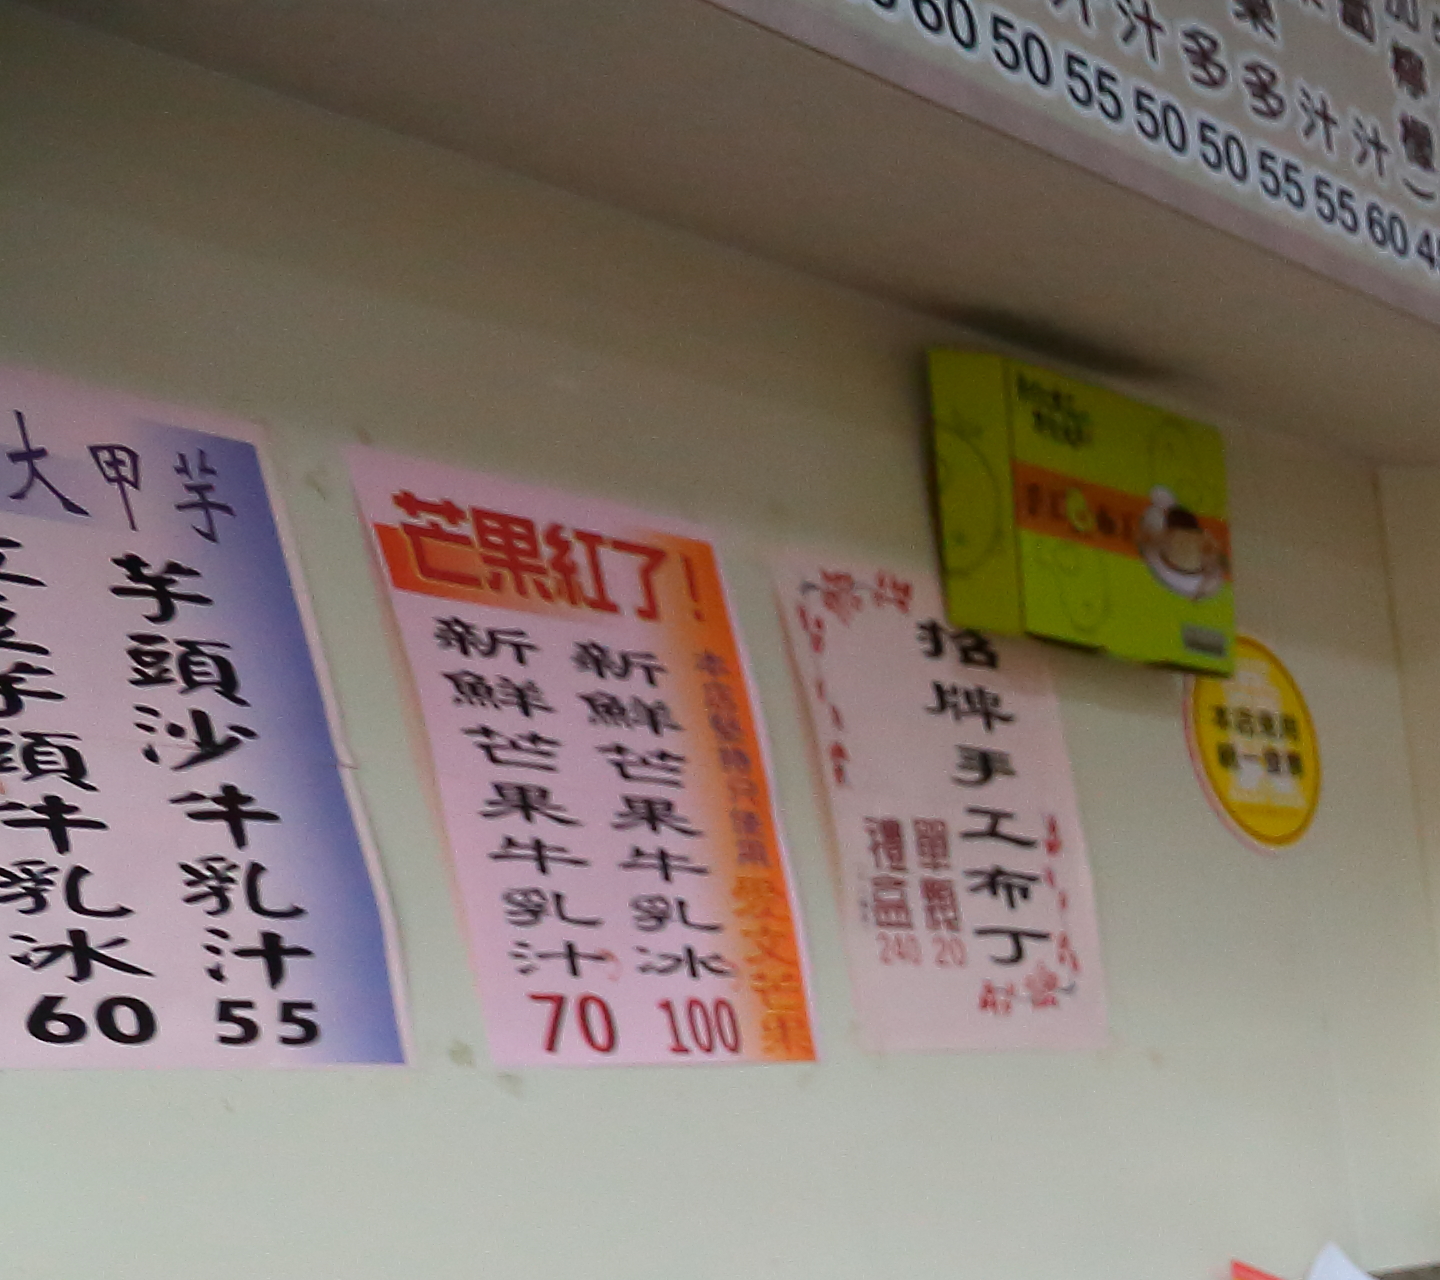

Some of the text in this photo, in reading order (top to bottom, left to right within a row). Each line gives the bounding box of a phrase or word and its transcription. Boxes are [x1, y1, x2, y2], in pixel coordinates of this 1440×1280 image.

[991, 14, 1051, 86] 50
[1064, 50, 1123, 121] 55
[1133, 86, 1188, 153] 50
[1199, 119, 1248, 182] 50
[1257, 149, 1306, 209] 55
[1314, 175, 1359, 235] 55
[1366, 203, 1408, 257] 60
[111, 553, 314, 990] 芋頭沙牛乳汁
[432, 616, 606, 978] 新鮮芒果牛乳汁
[570, 638, 737, 980] 新鮮芒果牛乳冰
[26, 997, 321, 1046] 60 55
[528, 993, 740, 1055] 70 100
